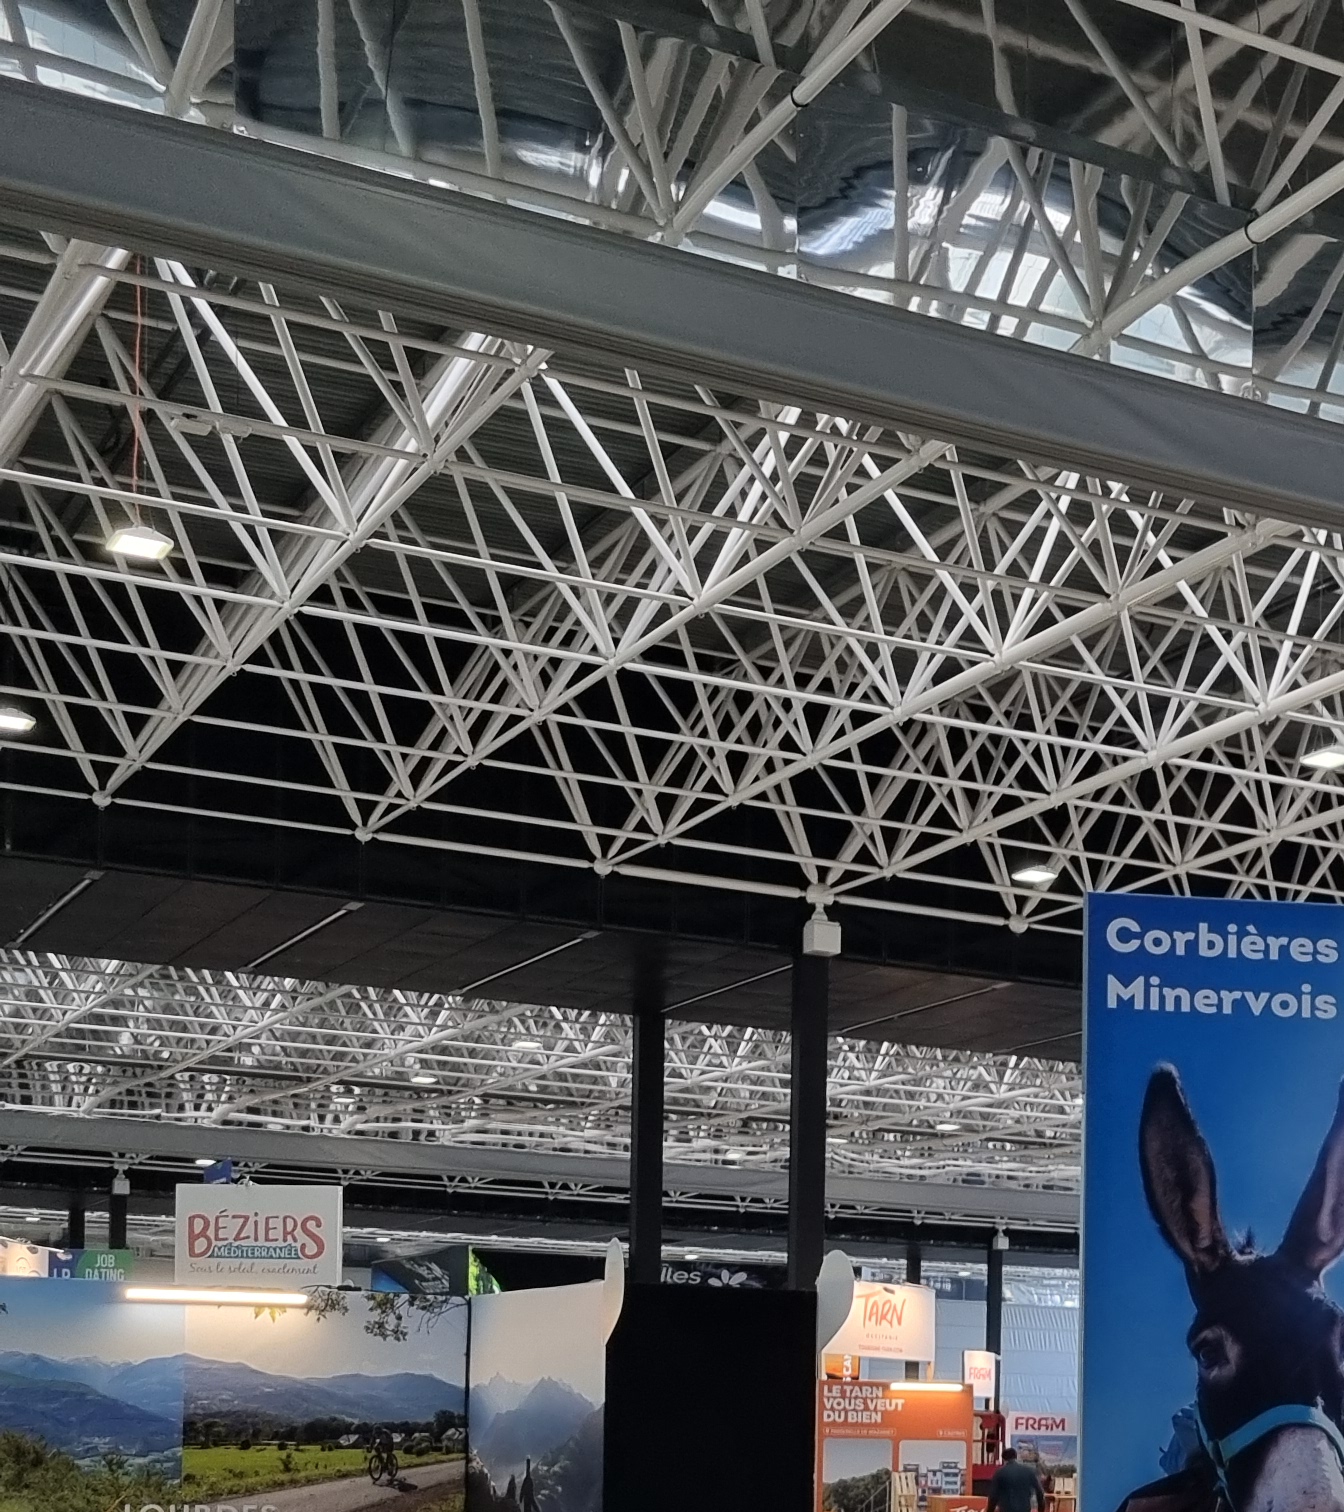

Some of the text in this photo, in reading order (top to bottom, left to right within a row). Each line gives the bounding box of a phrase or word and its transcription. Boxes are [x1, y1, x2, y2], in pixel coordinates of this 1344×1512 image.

[1106, 917, 1339, 964] Corbières
[1107, 974, 1338, 1019] Minervois
[95, 1254, 116, 1268] JOB
[85, 1268, 125, 1281] DATING
[855, 1289, 906, 1328] TARN
[823, 1385, 883, 1398] LE TARN
[823, 1398, 905, 1411] VOUS VEUT
[823, 1411, 882, 1423] DU BIEN
[1014, 1416, 1066, 1432] FRAM
